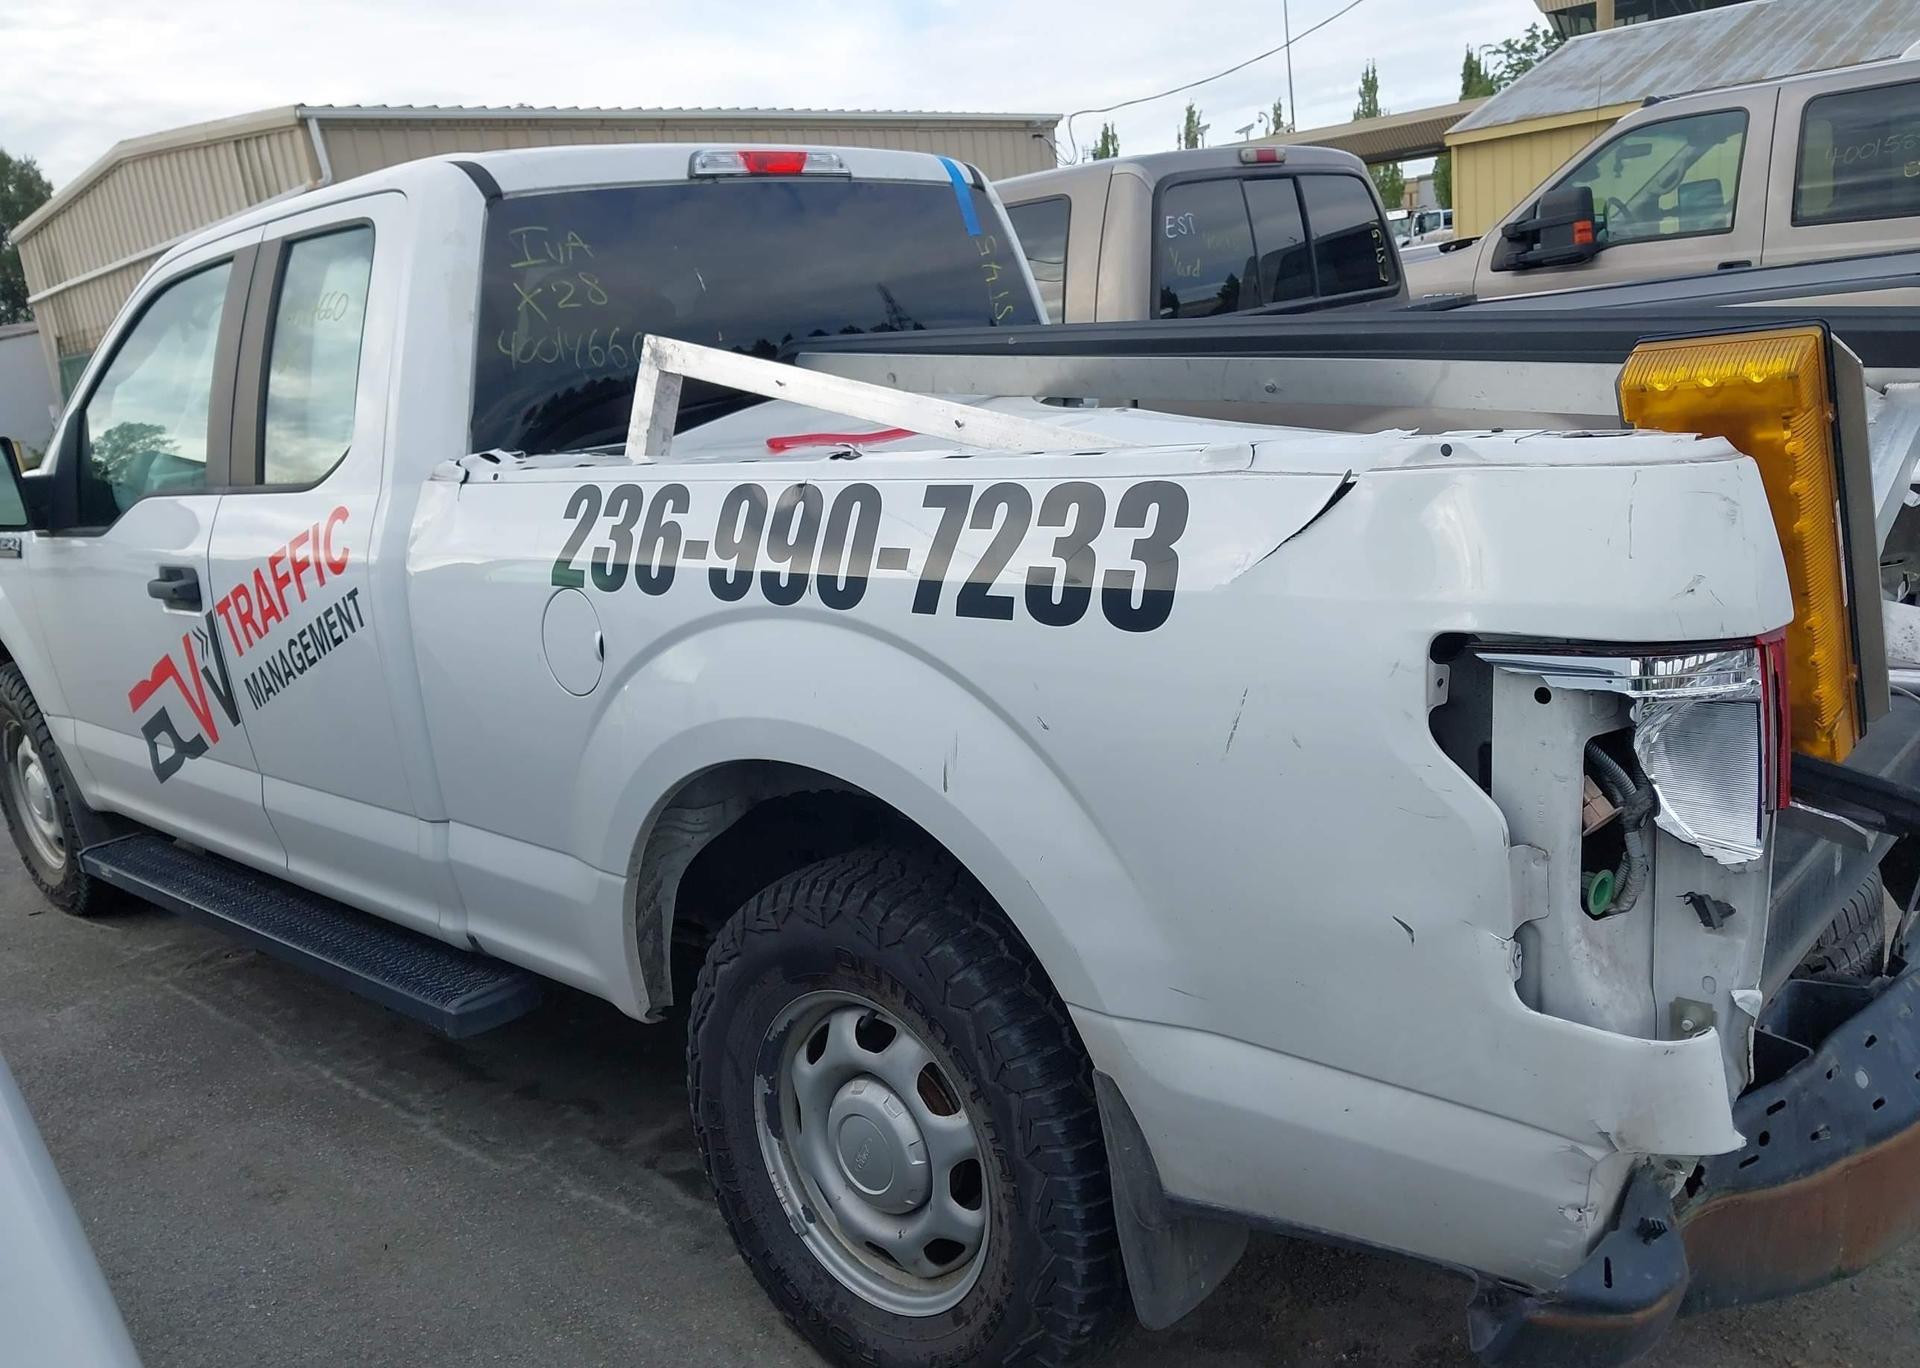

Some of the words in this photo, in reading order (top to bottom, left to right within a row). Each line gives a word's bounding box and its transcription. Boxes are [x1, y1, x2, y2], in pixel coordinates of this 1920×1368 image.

[1164, 212, 1196, 239] EST
[215, 506, 350, 658] TRAFFIC
[550, 480, 1190, 633] 236-990-7233
[244, 587, 366, 711] MANAGEMENT
